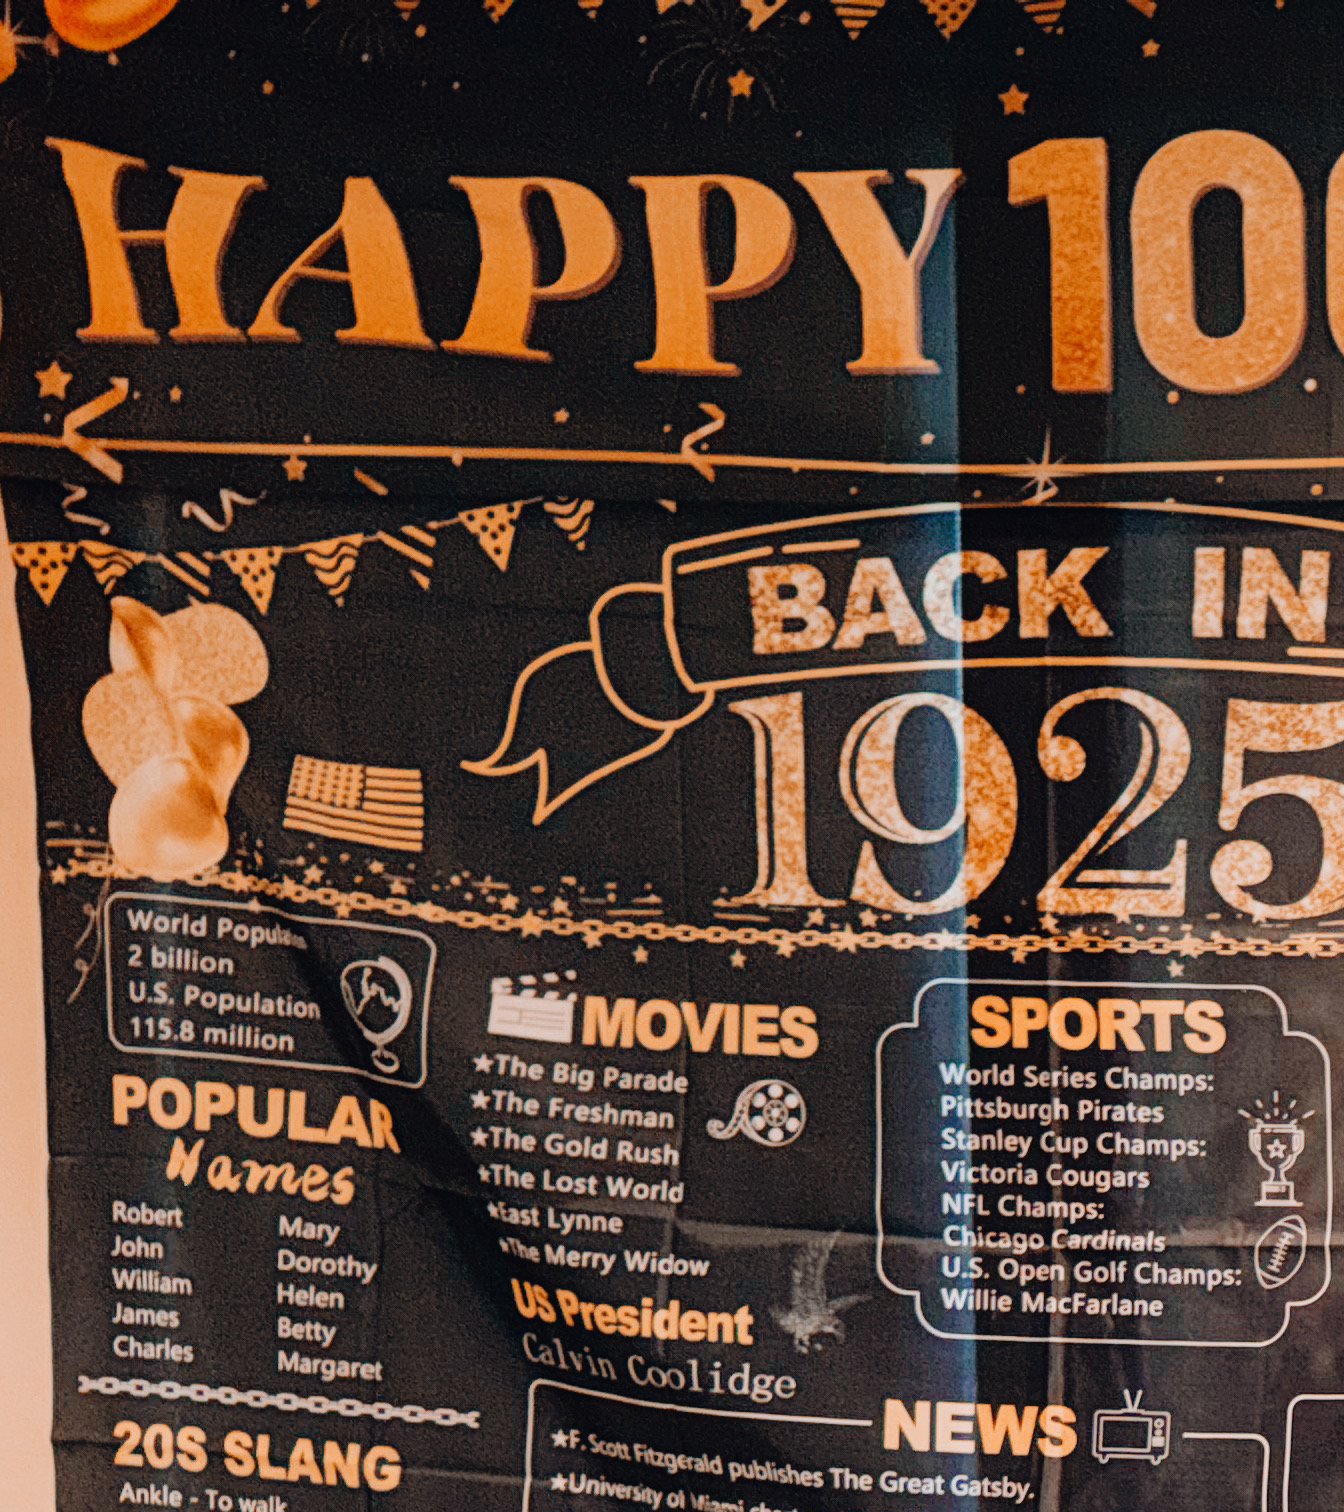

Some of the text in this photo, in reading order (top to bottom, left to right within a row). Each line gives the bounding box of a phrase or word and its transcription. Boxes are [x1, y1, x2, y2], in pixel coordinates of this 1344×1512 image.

[44, 135, 966, 376] HAPPY
[748, 546, 1330, 655] BACK IN
[127, 908, 207, 937] World
[128, 944, 234, 975] 2 billion
[129, 980, 321, 1020] U.S. Population
[130, 1016, 294, 1053] 115.8 million
[581, 995, 820, 1059] MOVIES
[970, 994, 1227, 1054] SPORTS
[495, 1053, 689, 1095] The Big Parade
[939, 1062, 1215, 1097] World Series Champs:
[112, 1074, 401, 1153] POPULAR
[491, 1088, 674, 1129] The Freshman
[939, 1095, 1165, 1126] Pittsburgh Pirates
[488, 1125, 680, 1167] The Gold Rush
[940, 1127, 1207, 1161] Stanley Cup Champs:
[166, 1136, 355, 1205] Names
[489, 1163, 685, 1204] The Lost World
[940, 1160, 1150, 1193] Victoria Cougars
[111, 1200, 184, 1228] Robert
[942, 1193, 1105, 1222] NFL Champs:
[111, 1235, 164, 1260] John
[278, 1214, 341, 1247] Mary
[943, 1225, 1167, 1255] Chicago Cardinals
[111, 1267, 193, 1296] William
[277, 1249, 378, 1285] Dorothy
[942, 1257, 1242, 1290] U.S. Open Golf Champs:
[277, 1282, 345, 1310] Helen
[511, 1278, 754, 1346] US President
[941, 1287, 1164, 1317] Willie MacFarlane
[111, 1301, 180, 1329] James
[277, 1316, 337, 1348] Betty
[113, 1335, 194, 1363] Charles
[277, 1350, 383, 1382] Margaret
[522, 1332, 797, 1404] Calvin Coolidge
[881, 1397, 1078, 1460] NEWS
[112, 1420, 402, 1492] 20S SLANG
[589, 1432, 632, 1462] Scott
[633, 1443, 724, 1476] Fitzgerald
[728, 1460, 824, 1489] publishes
[829, 1467, 873, 1492] The
[879, 1469, 945, 1499] Great
[950, 1472, 1035, 1503] Gatsby.
[119, 1482, 183, 1508] Ankle
[205, 1488, 233, 1512] To
